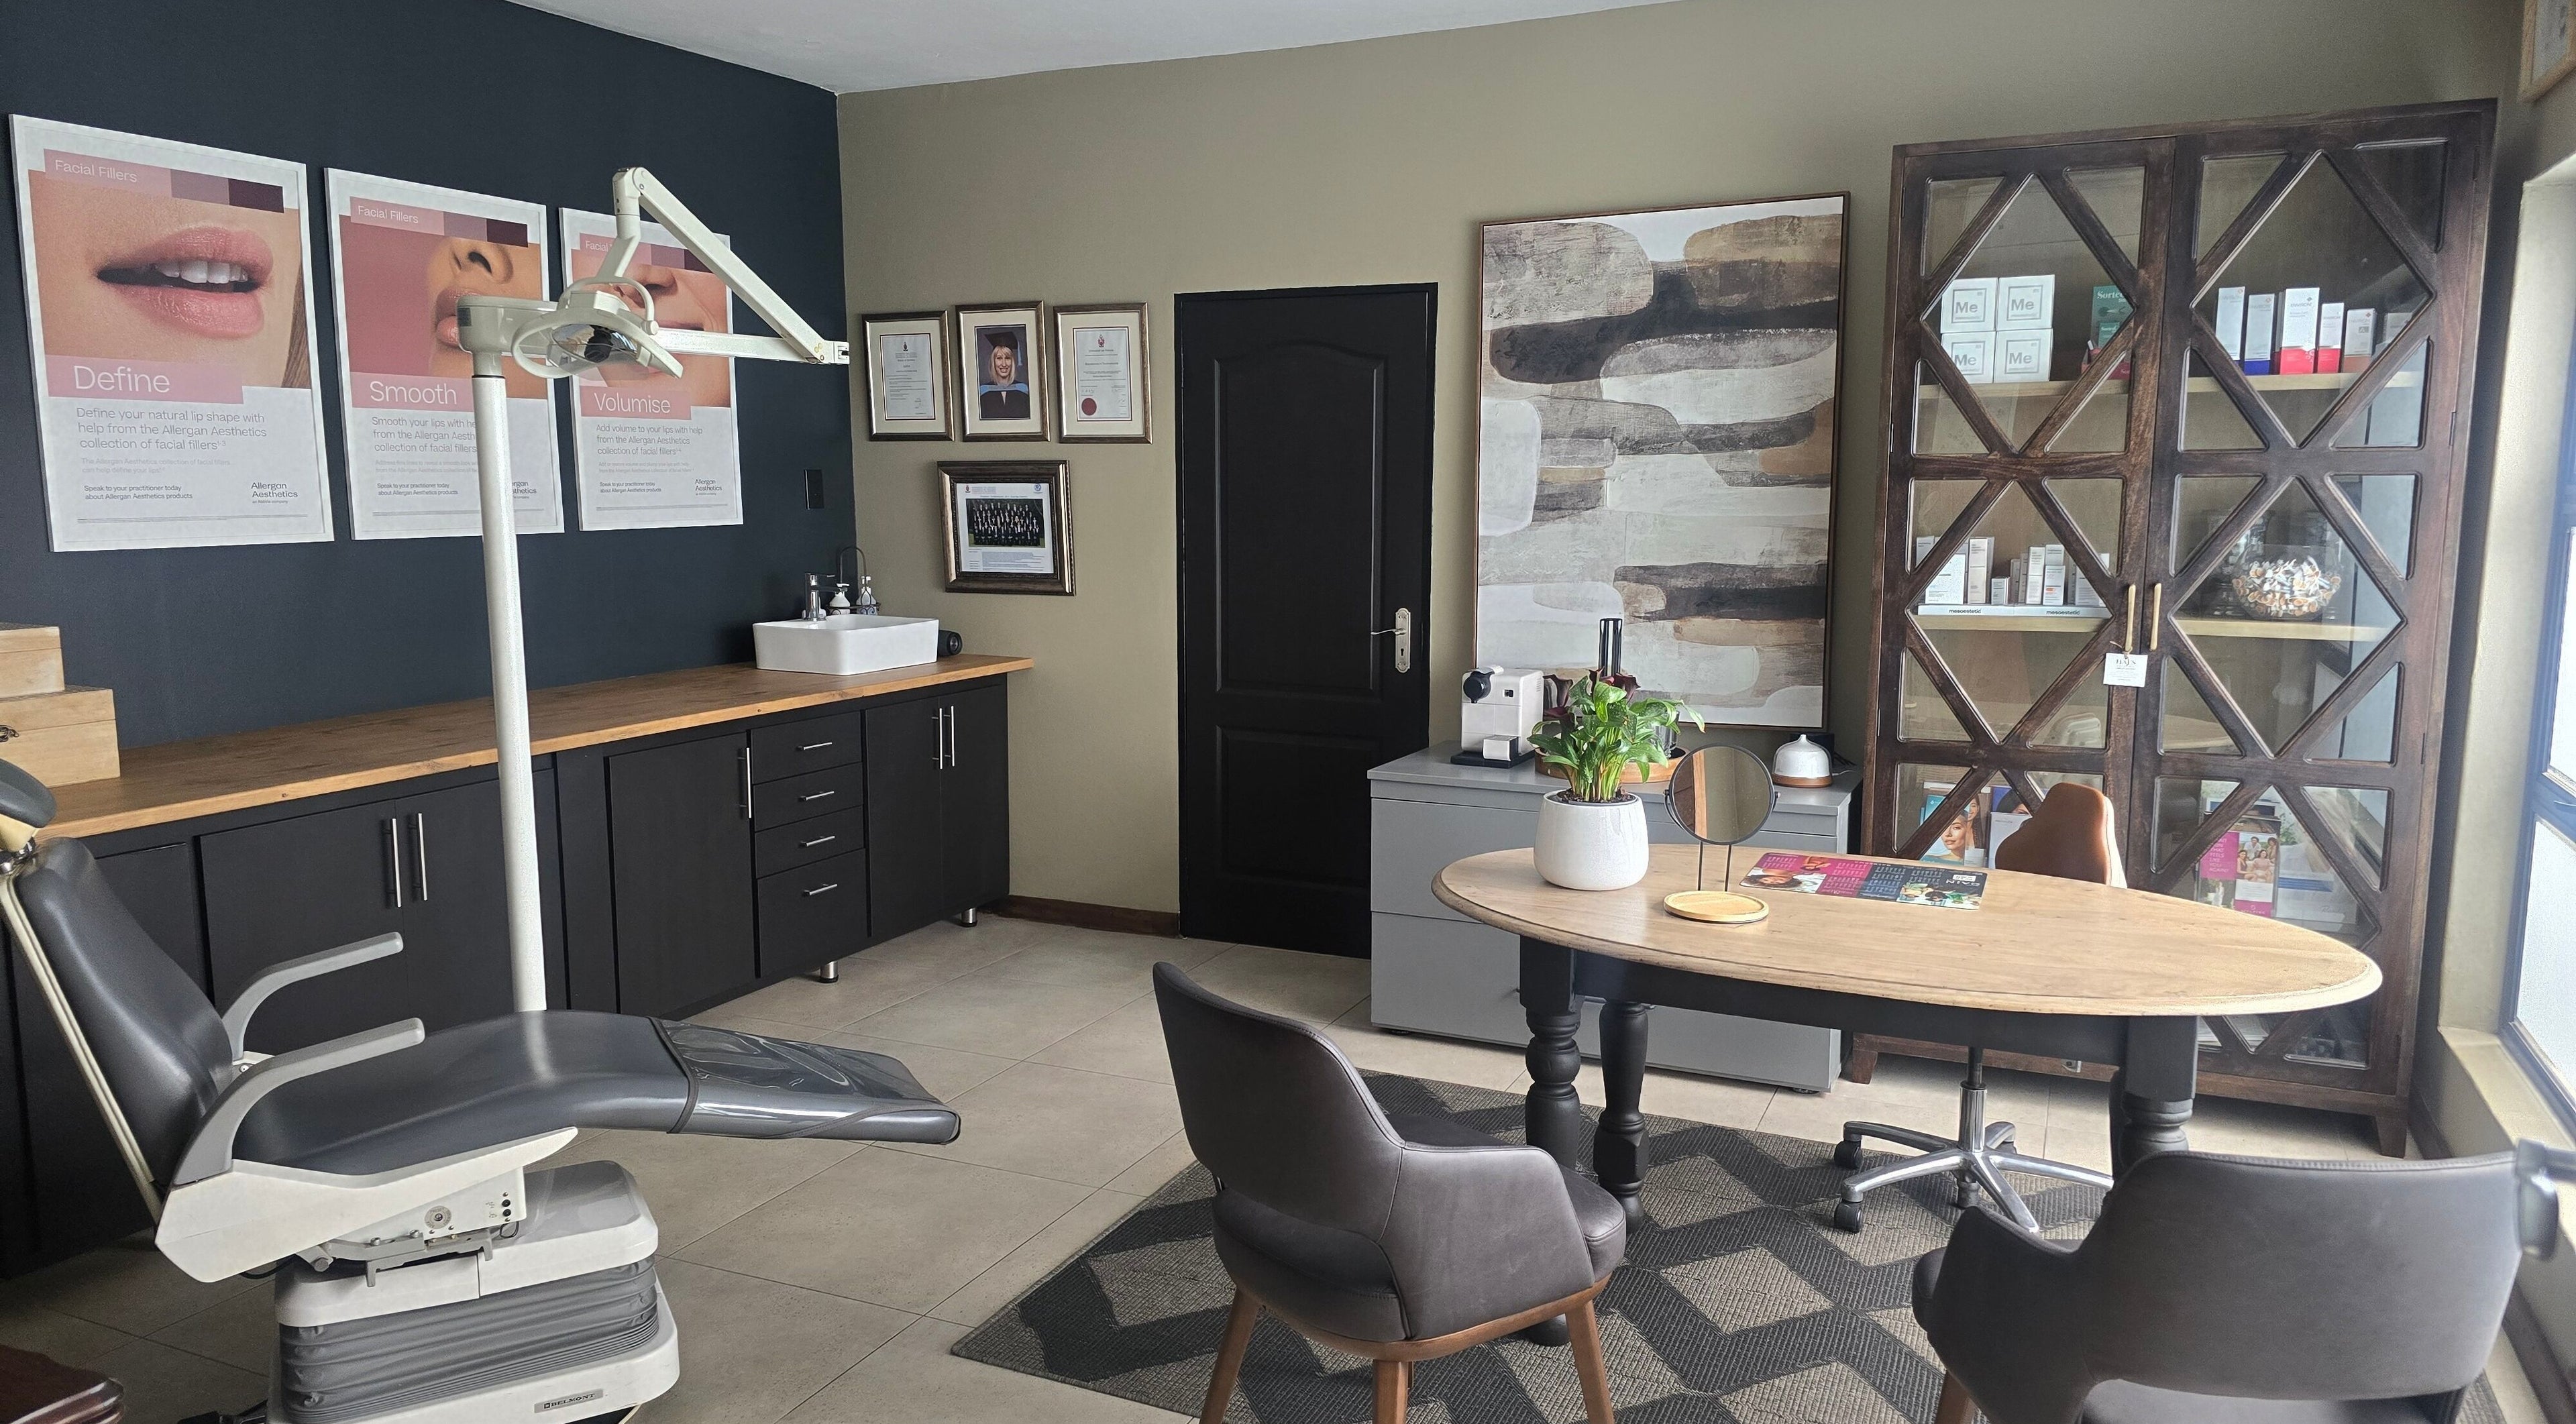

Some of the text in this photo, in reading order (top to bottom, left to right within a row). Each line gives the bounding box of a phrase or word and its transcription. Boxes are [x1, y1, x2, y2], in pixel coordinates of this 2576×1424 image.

[55, 160, 138, 182] Facial Fillers
[358, 205, 419, 223] Facial Fillers
[586, 240, 608, 252] Facial
[1955, 302, 1978, 313] Me
[2012, 298, 2034, 311] Me
[1955, 354, 1976, 366] Me
[2009, 352, 2032, 364] Me
[74, 366, 170, 393] Define
[370, 381, 457, 404] Smooth
[594, 392, 671, 413] Volumise
[76, 408, 264, 424] Define your natural lip shape with
[372, 417, 476, 428] Smooth your lips with he
[78, 423, 267, 437] help from the Allergan Aesthetics
[373, 430, 476, 441] from the Allergan Aesth
[612, 424, 637, 433] volume
[663, 426, 674, 435] lips
[689, 427, 702, 435] help
[80, 438, 137, 448] collection
[140, 439, 152, 449] of
[156, 439, 185, 449] facial
[597, 435, 614, 443] from
[628, 437, 655, 445] Allergan
[374, 443, 417, 451] collection
[419, 443, 428, 451] of
[430, 444, 452, 452] facial
[598, 447, 630, 455] collection
[251, 482, 287, 490] Allergan
[551, 1393, 595, 1407] BELMONT
